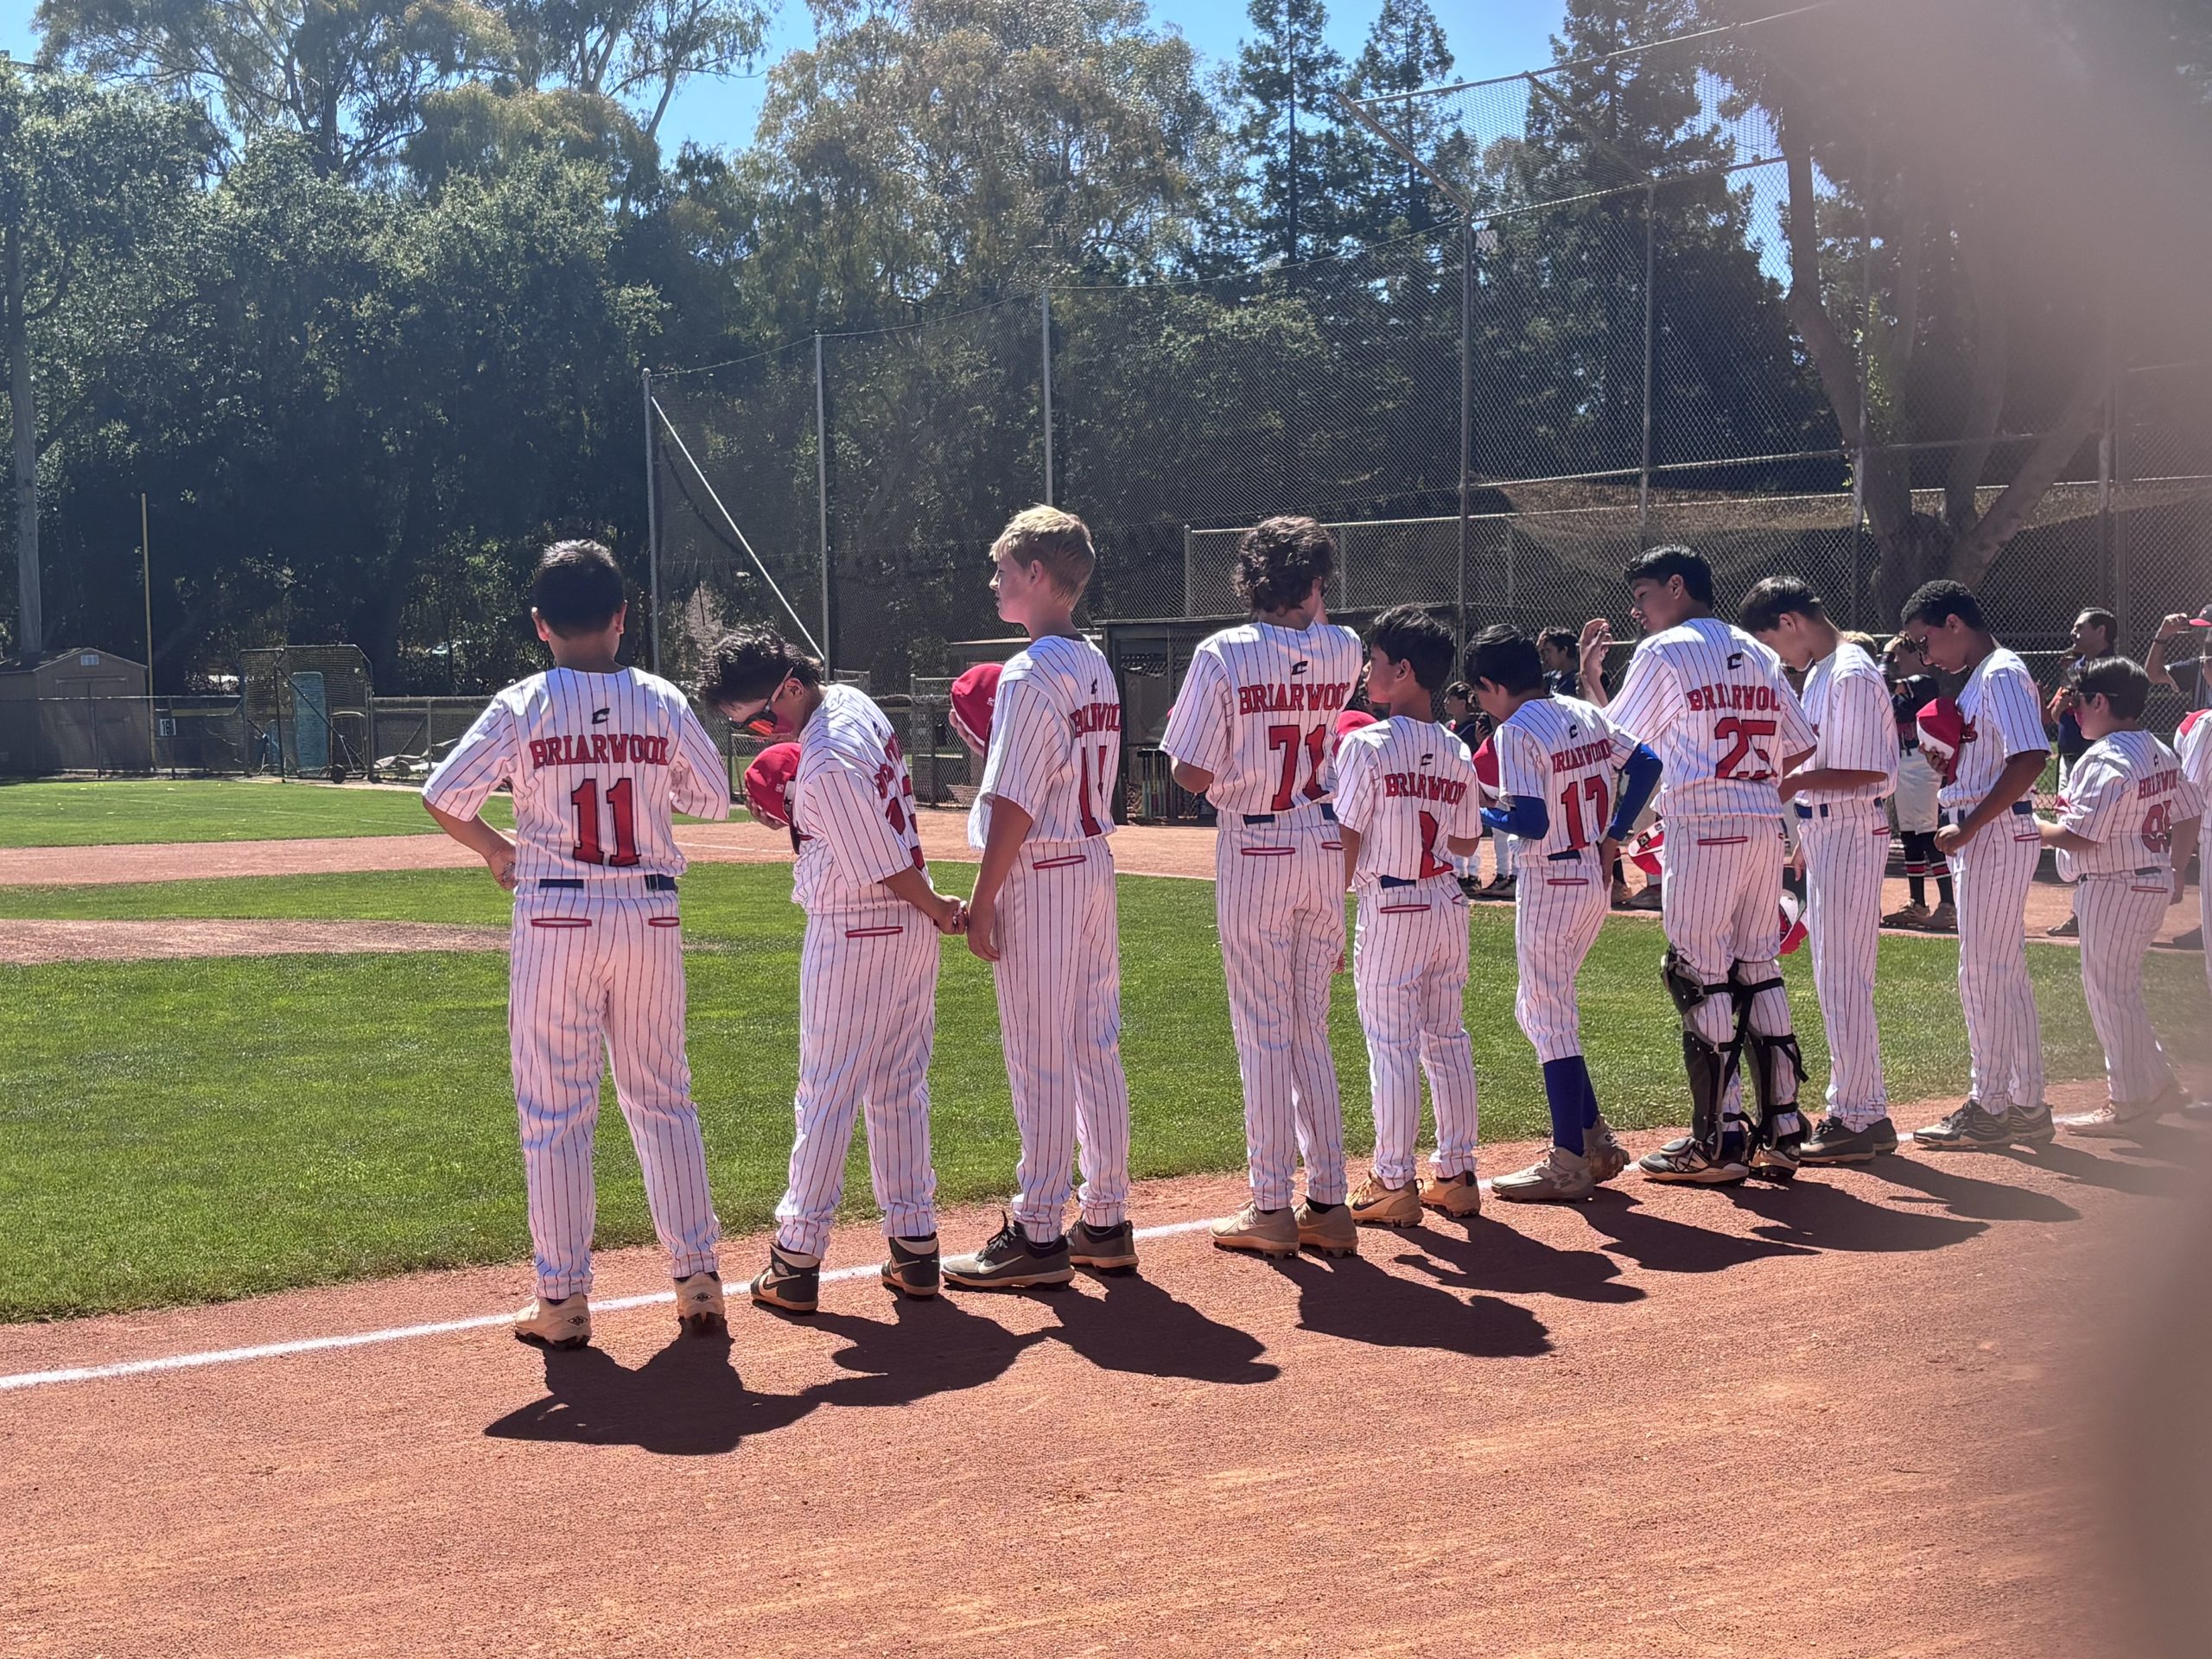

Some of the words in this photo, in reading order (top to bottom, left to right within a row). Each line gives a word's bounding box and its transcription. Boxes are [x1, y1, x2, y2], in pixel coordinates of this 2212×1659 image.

[1238, 682, 1351, 715] BRIARWOO
[1268, 724, 1331, 810] 71
[1714, 716, 1777, 780] 25
[571, 778, 641, 867] 11
